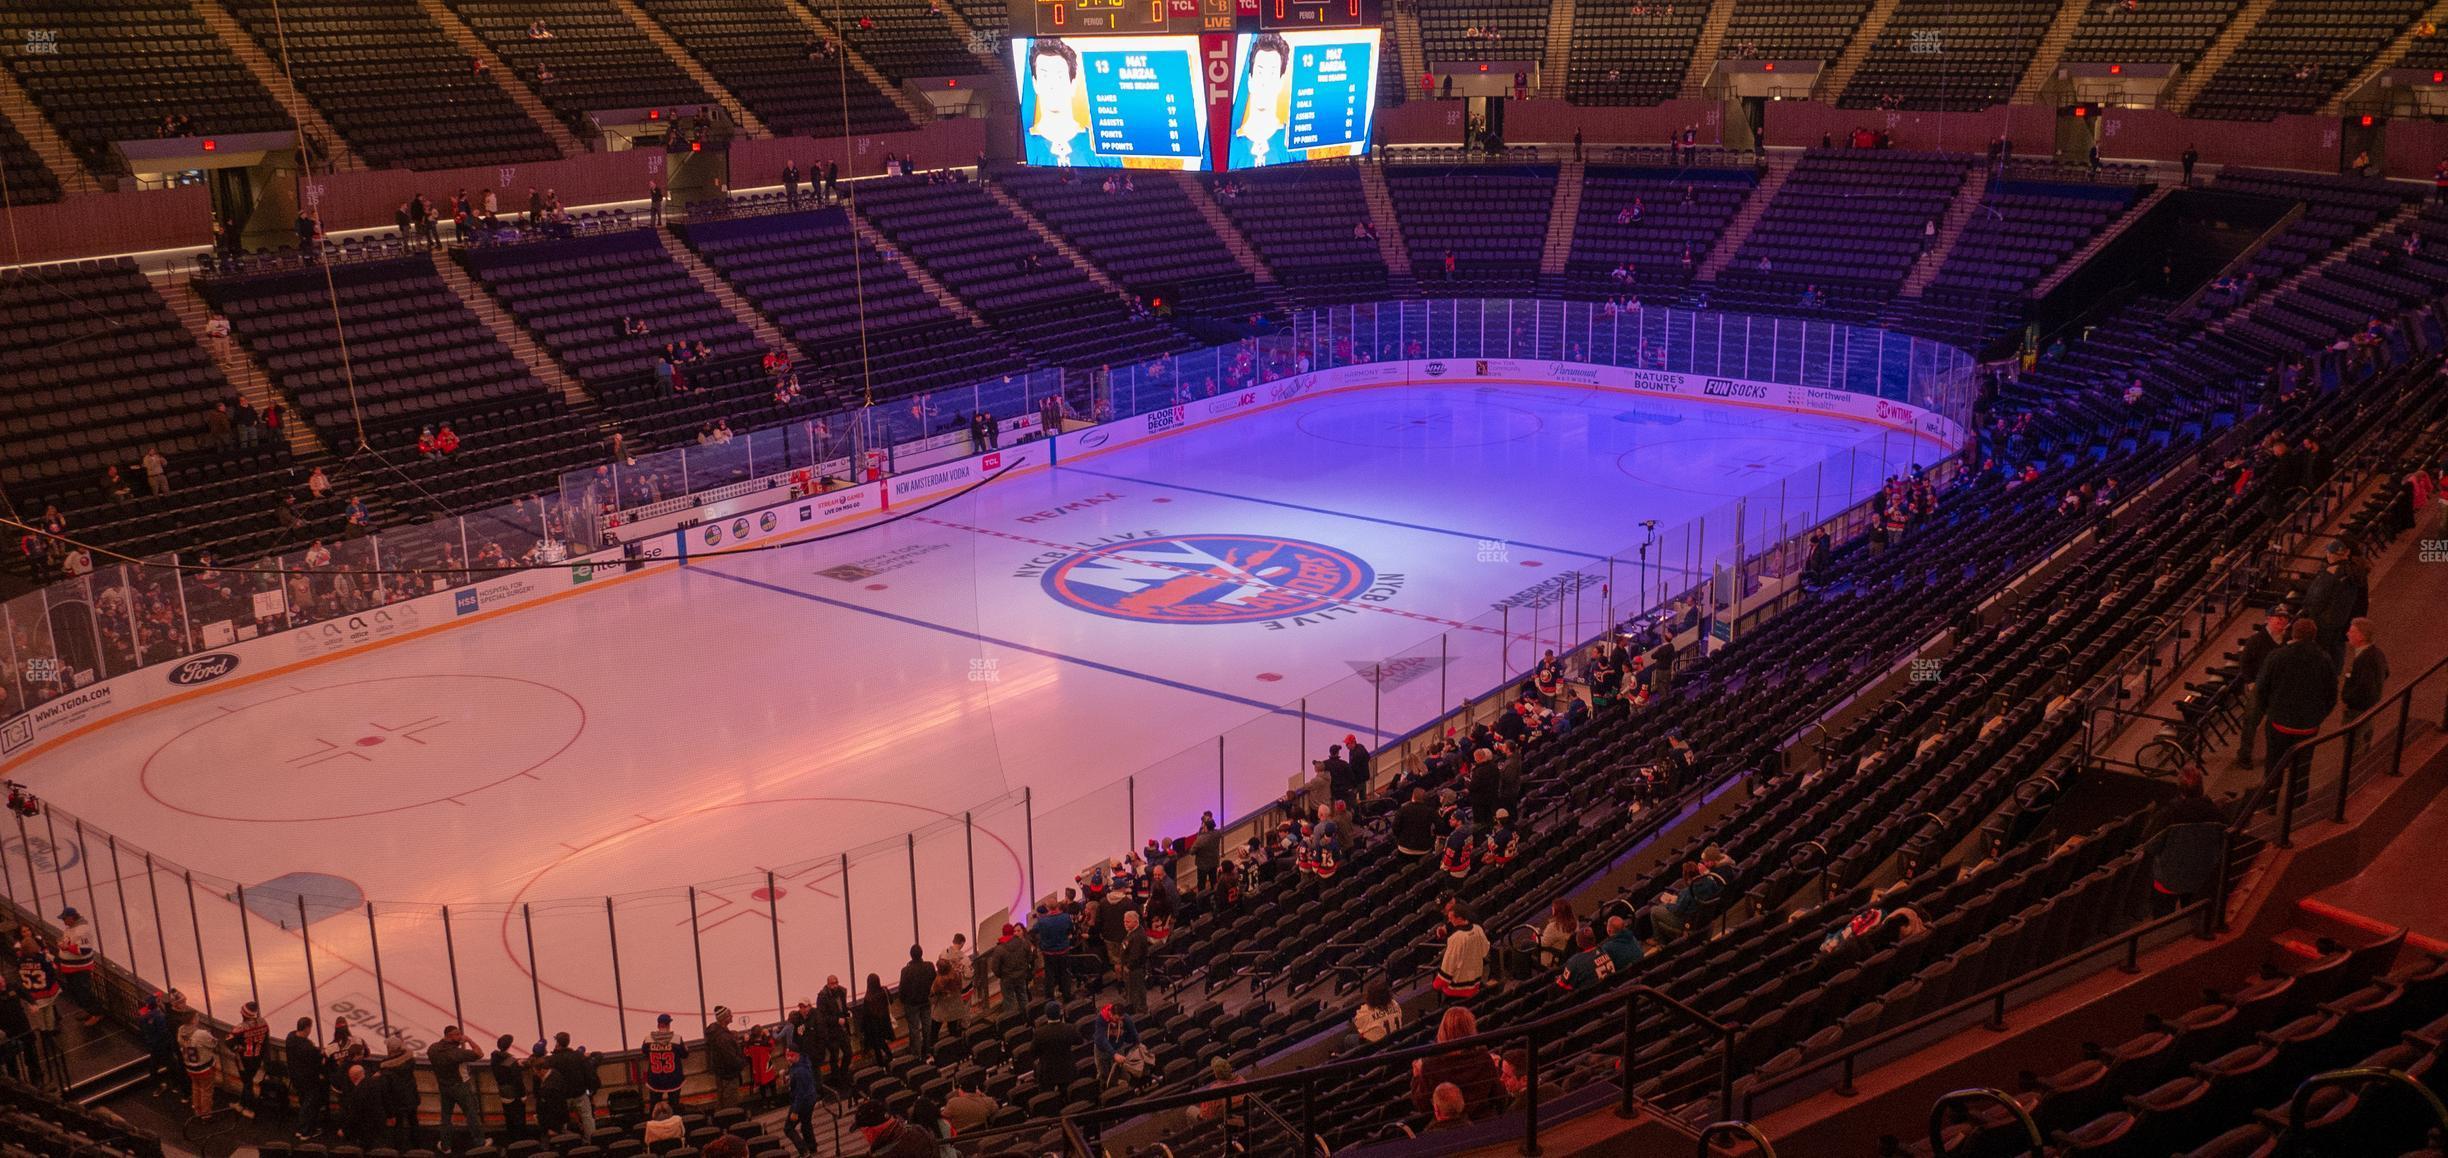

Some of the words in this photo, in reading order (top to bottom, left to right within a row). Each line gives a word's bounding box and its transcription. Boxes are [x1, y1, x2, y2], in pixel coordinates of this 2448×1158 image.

[1152, 0, 1162, 22] 0
[1172, 0, 1194, 10] TCL
[1240, 0, 1258, 8] TCL
[1054, 4, 1064, 24] 0
[1110, 14, 1114, 28] 1
[1299, 11, 1315, 20] PERIOD
[1084, 18, 1104, 26] PERIOD
[1204, 17, 1231, 28] LIVE
[1095, 60, 1110, 74] 13
[1208, 40, 1228, 105] TCL
[1100, 130, 1122, 138] POINTS
[1112, 142, 1134, 150] POINTS
[500, 168, 515, 178] 117
[306, 185, 324, 195] 116
[500, 179, 511, 188] 17
[1554, 363, 1597, 378] Paramount
[1634, 372, 1684, 384] NATURE'S
[1634, 380, 1678, 392] BOUNTY
[1707, 380, 1731, 396] FUN
[1731, 384, 1768, 399] SOCKS
[1238, 392, 1255, 406] ACE
[1808, 389, 1851, 402] Northwell
[1807, 401, 1834, 410] Health
[1876, 400, 1913, 424] SHOWTIME
[1148, 409, 1174, 421] FLOOR
[1148, 416, 1174, 430] DECOR
[984, 458, 998, 468] TCL
[896, 482, 910, 496] NEW
[910, 475, 948, 492] AMSTERDAM
[950, 466, 970, 486] VODKA
[824, 508, 834, 516] LIVE
[1016, 492, 1126, 524] RE/MAX
[1014, 551, 1068, 578] NYCB
[1077, 529, 1165, 547] LIVE
[578, 547, 662, 577] enterse
[480, 585, 509, 596] HOSPITAL
[1362, 573, 1405, 602] NYCB
[458, 596, 476, 608] HSS
[480, 593, 506, 604] SPECIAL
[507, 586, 534, 597] SURGERY
[1260, 606, 1357, 630] LIVE
[180, 657, 228, 683] Ford
[35, 687, 111, 722] WWW.TGIOA.COM
[20, 970, 46, 989] 53
[650, 1052, 675, 1074] 53
